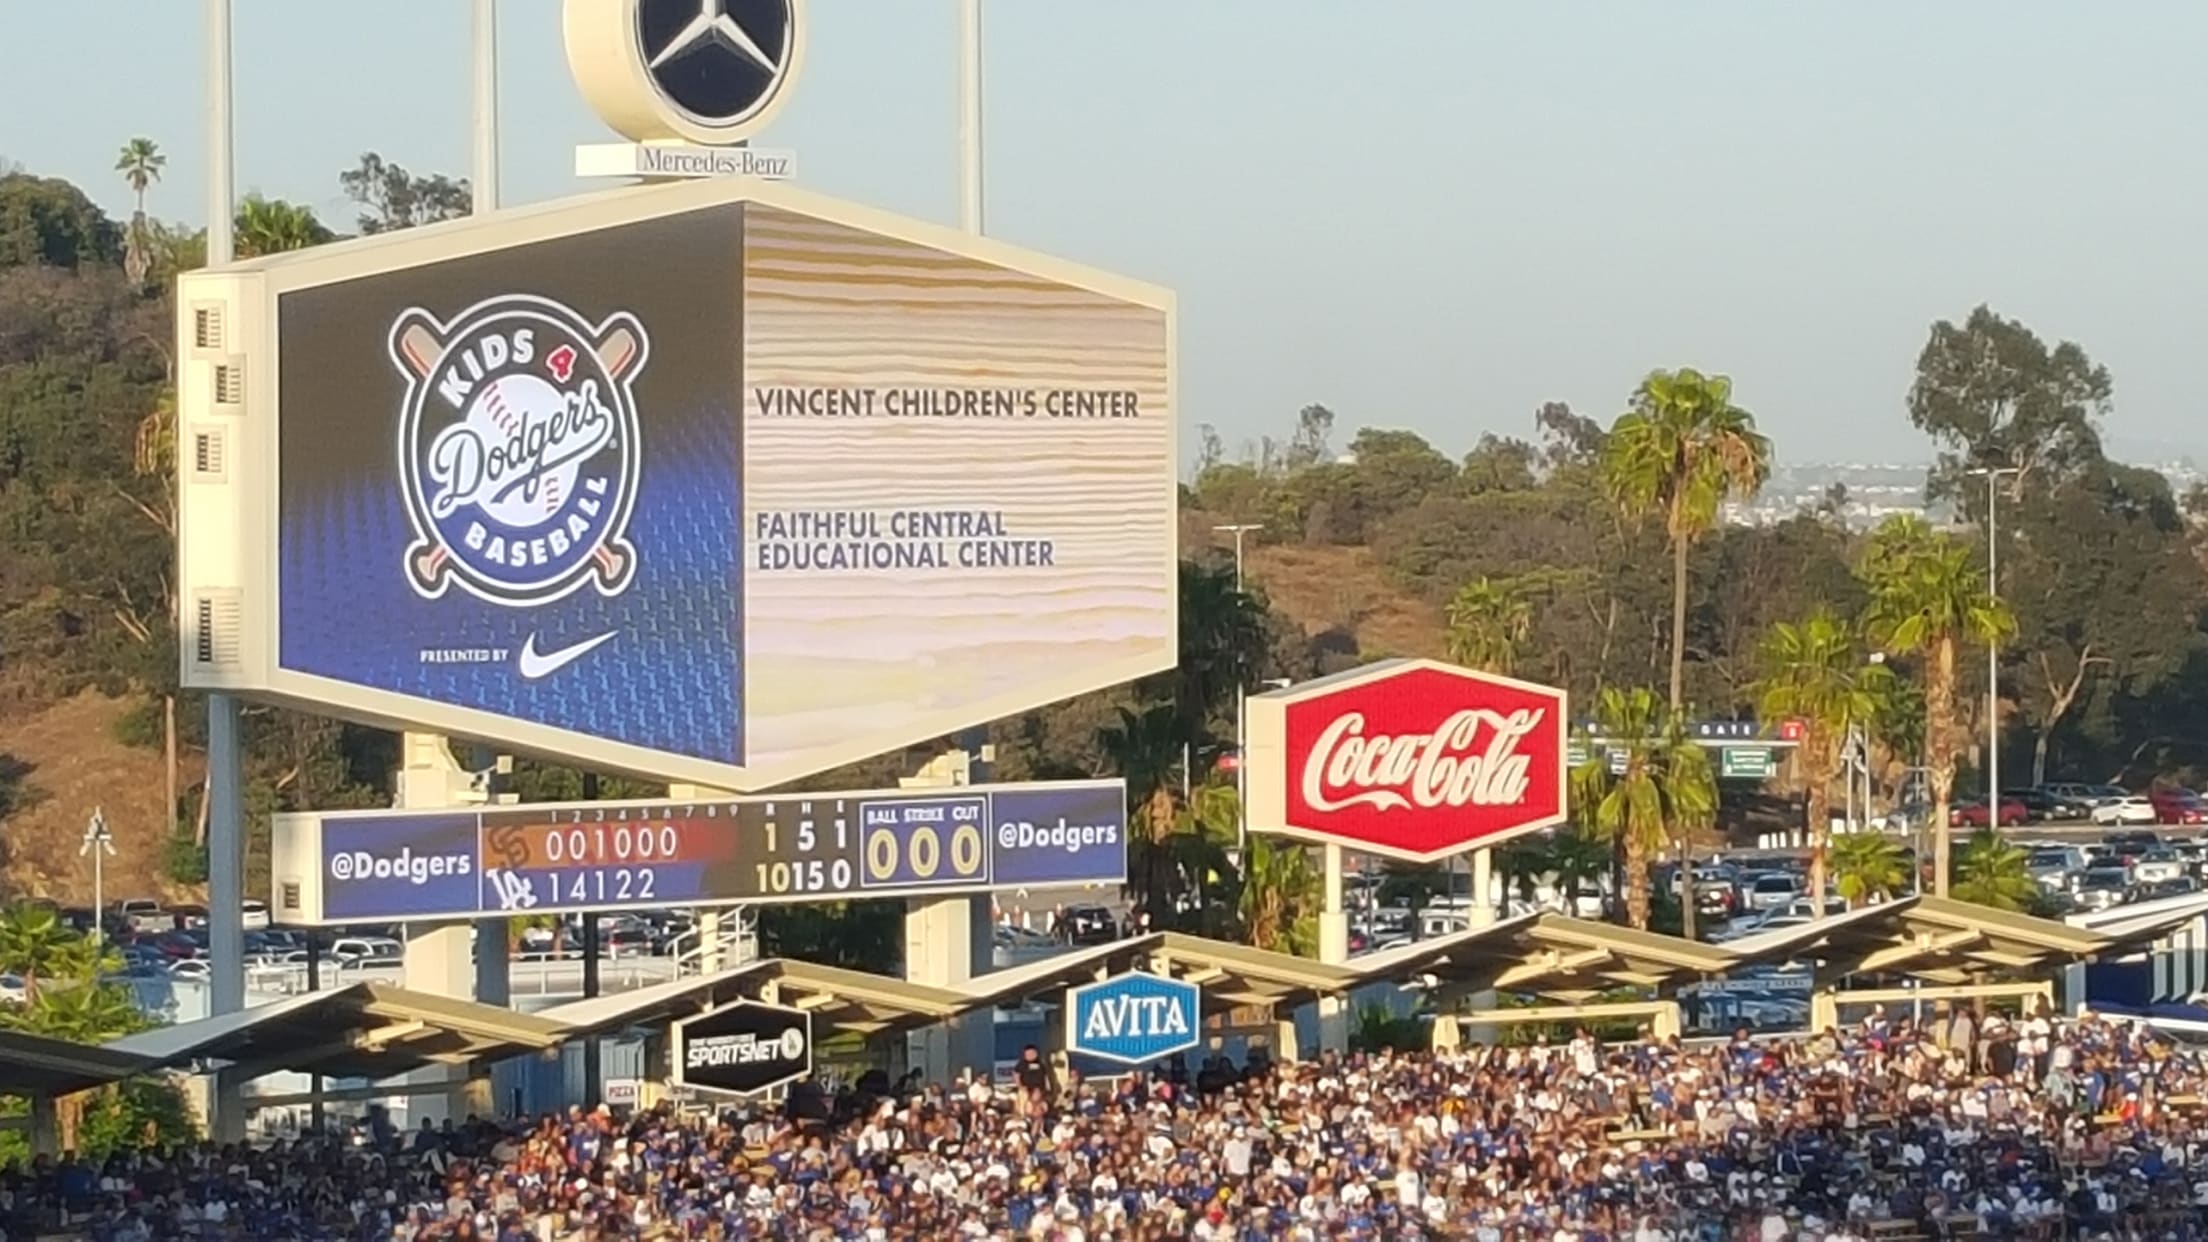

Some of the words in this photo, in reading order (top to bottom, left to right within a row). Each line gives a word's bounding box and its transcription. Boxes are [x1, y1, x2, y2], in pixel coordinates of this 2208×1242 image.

[643, 149, 788, 175] Mercedes-Benz
[438, 329, 534, 408] KIDS
[545, 344, 577, 382] 4
[755, 388, 876, 416] VINCENT
[885, 389, 1037, 417] CHILDREN'S
[1045, 390, 1139, 417] CENTER
[430, 383, 612, 516] Dodgers
[464, 476, 608, 567] BASEBALL
[757, 512, 881, 539] FAITHFUL
[890, 511, 1007, 538] CENTRAL
[758, 542, 949, 570] EDUCATIONAL
[959, 541, 1054, 566] CENTER
[420, 648, 490, 663] PRESENTED
[492, 648, 509, 661] BY
[1303, 707, 1544, 812] Coca-Cola
[867, 809, 898, 825] BALL
[904, 806, 944, 823] STRIKE
[952, 805, 978, 820] OUT
[765, 822, 776, 852] 1
[798, 820, 815, 851] 5
[834, 819, 846, 848] 1
[867, 828, 898, 879] 0
[909, 826, 939, 877] 0
[951, 824, 981, 875] 0
[999, 818, 1117, 853] @Dodgers
[330, 847, 471, 885] @Dodgers
[756, 861, 790, 892] 10
[792, 860, 824, 890] 15
[831, 858, 850, 889] 0
[1084, 994, 1188, 1038] AVITA
[687, 1037, 781, 1068] SPORTSNET
